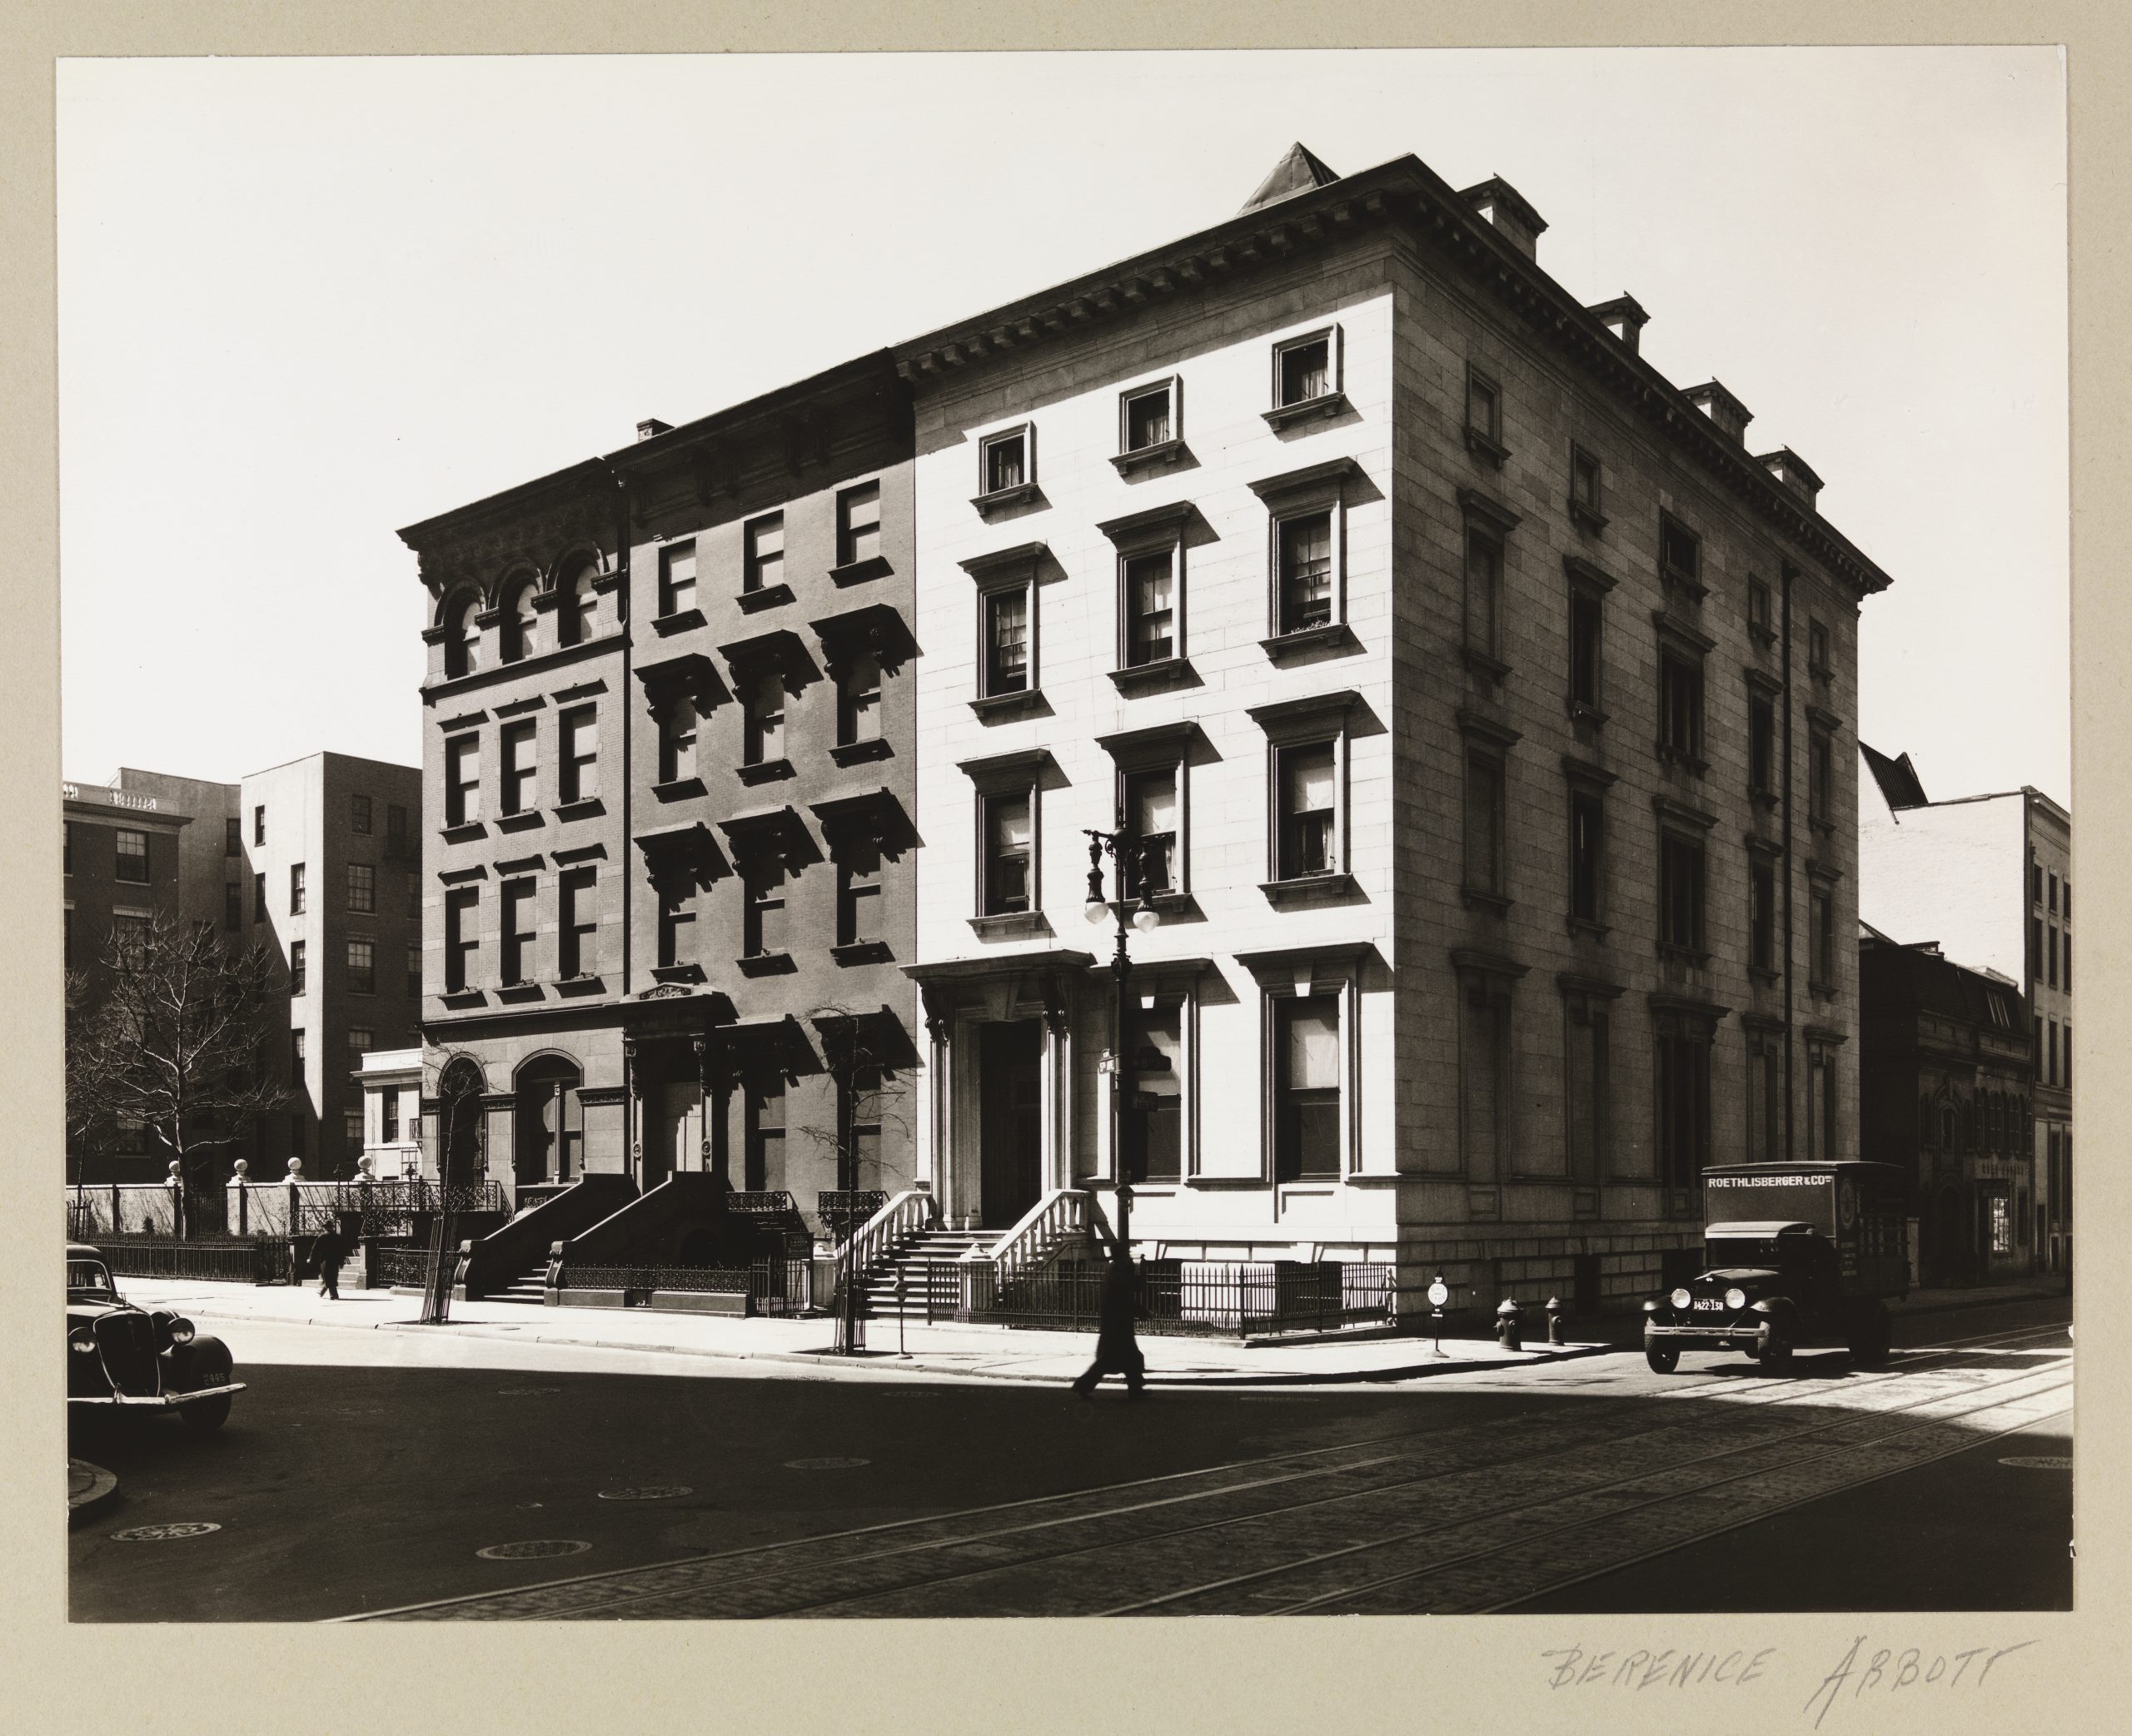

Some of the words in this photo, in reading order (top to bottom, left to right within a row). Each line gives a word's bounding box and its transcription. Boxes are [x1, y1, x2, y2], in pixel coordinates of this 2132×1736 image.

[1708, 1176, 1803, 1188] ROETHLISBERGER
[1542, 1643, 1777, 1691] BERENICE
[1802, 1634, 2041, 1729] ABBOTT
